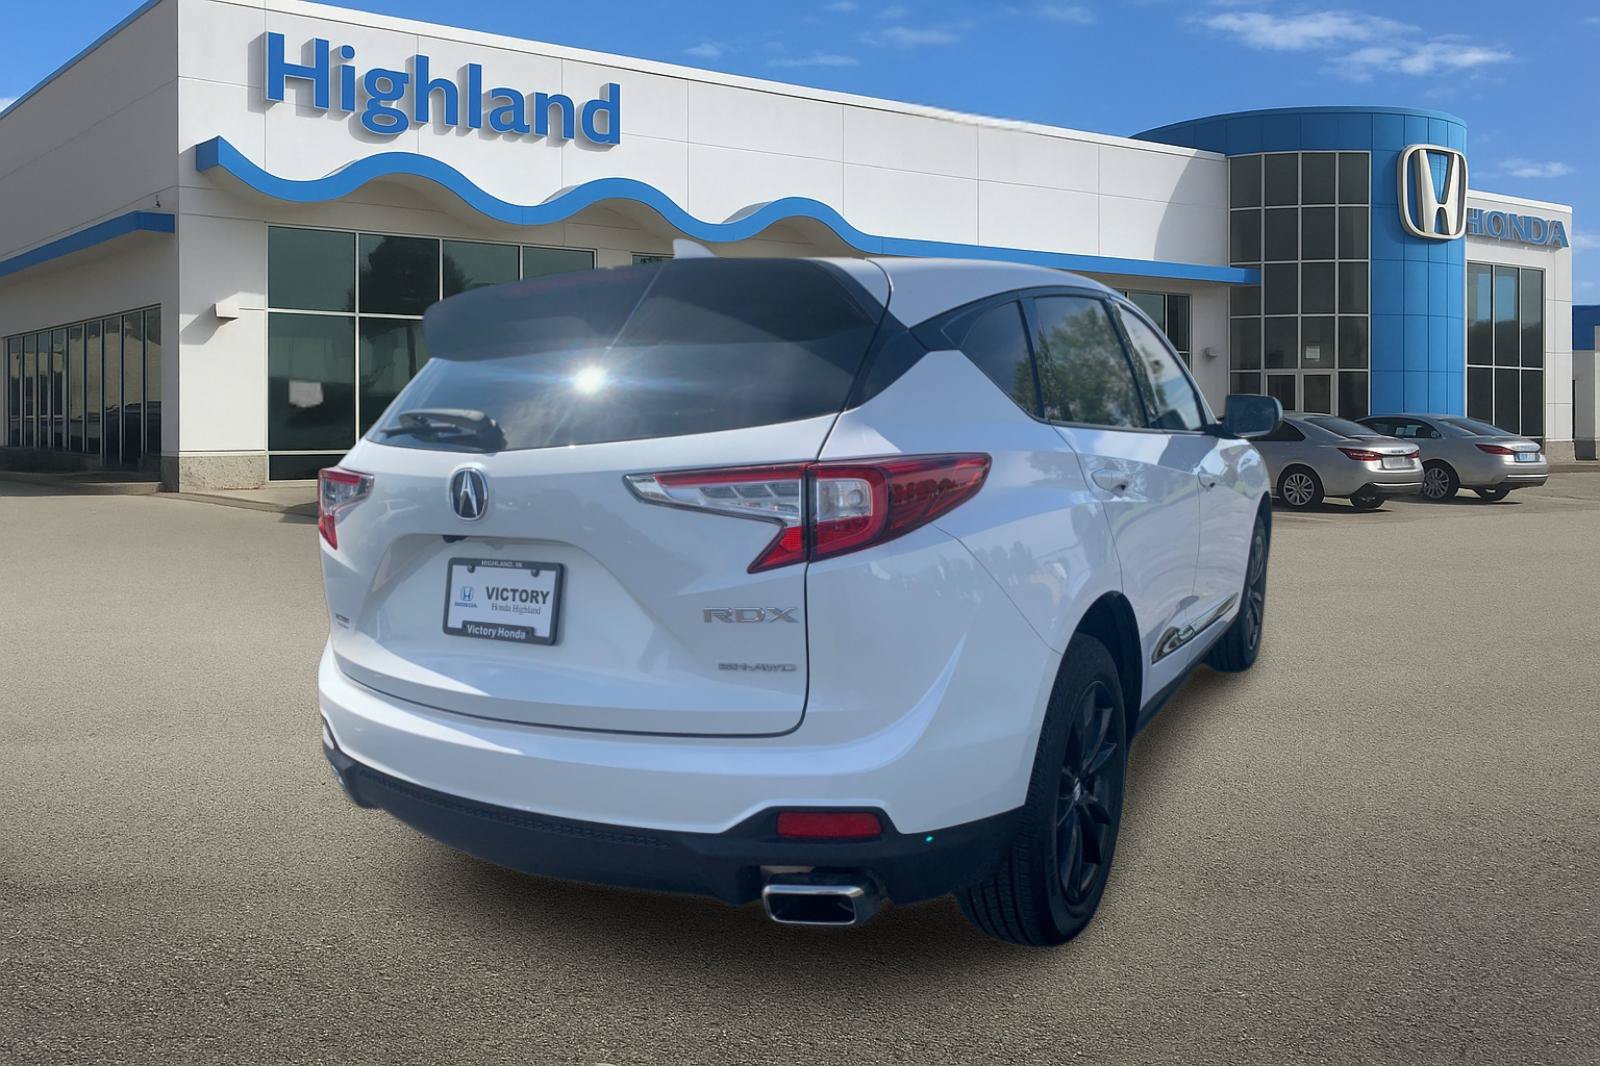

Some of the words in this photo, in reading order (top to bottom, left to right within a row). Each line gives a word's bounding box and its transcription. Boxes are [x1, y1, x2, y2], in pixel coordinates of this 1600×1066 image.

[266, 31, 621, 145] Highland
[1467, 207, 1570, 249] HONDA
[485, 586, 550, 605] VICTORY
[703, 607, 799, 624] RDX
[466, 624, 497, 638] Victory
[498, 626, 526, 640] Honda
